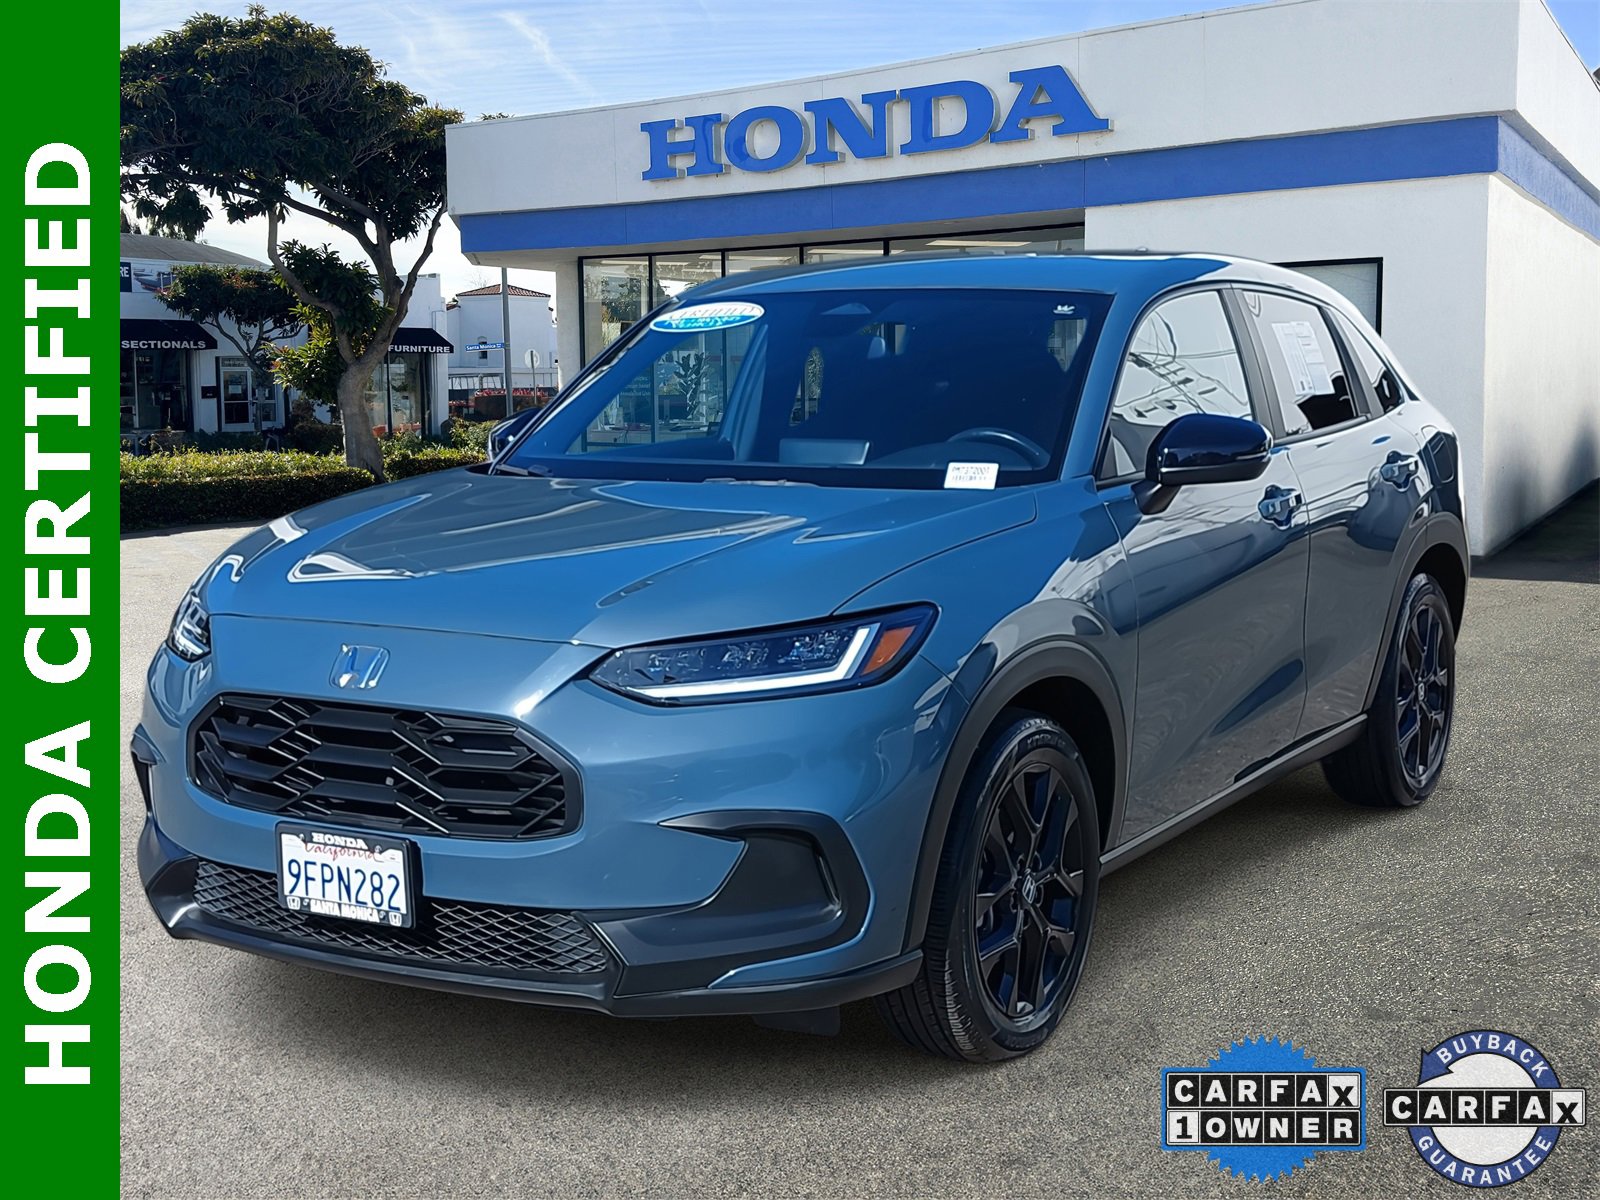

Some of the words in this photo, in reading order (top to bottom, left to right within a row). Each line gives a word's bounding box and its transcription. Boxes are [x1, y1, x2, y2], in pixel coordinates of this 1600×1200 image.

[641, 65, 1111, 181] HONDA
[121, 340, 206, 349] SECTIONALS
[388, 344, 450, 353] FURNITURE
[311, 832, 368, 850] HONDA
[288, 858, 401, 912] 9FPN282
[341, 902, 380, 923] MONICA
